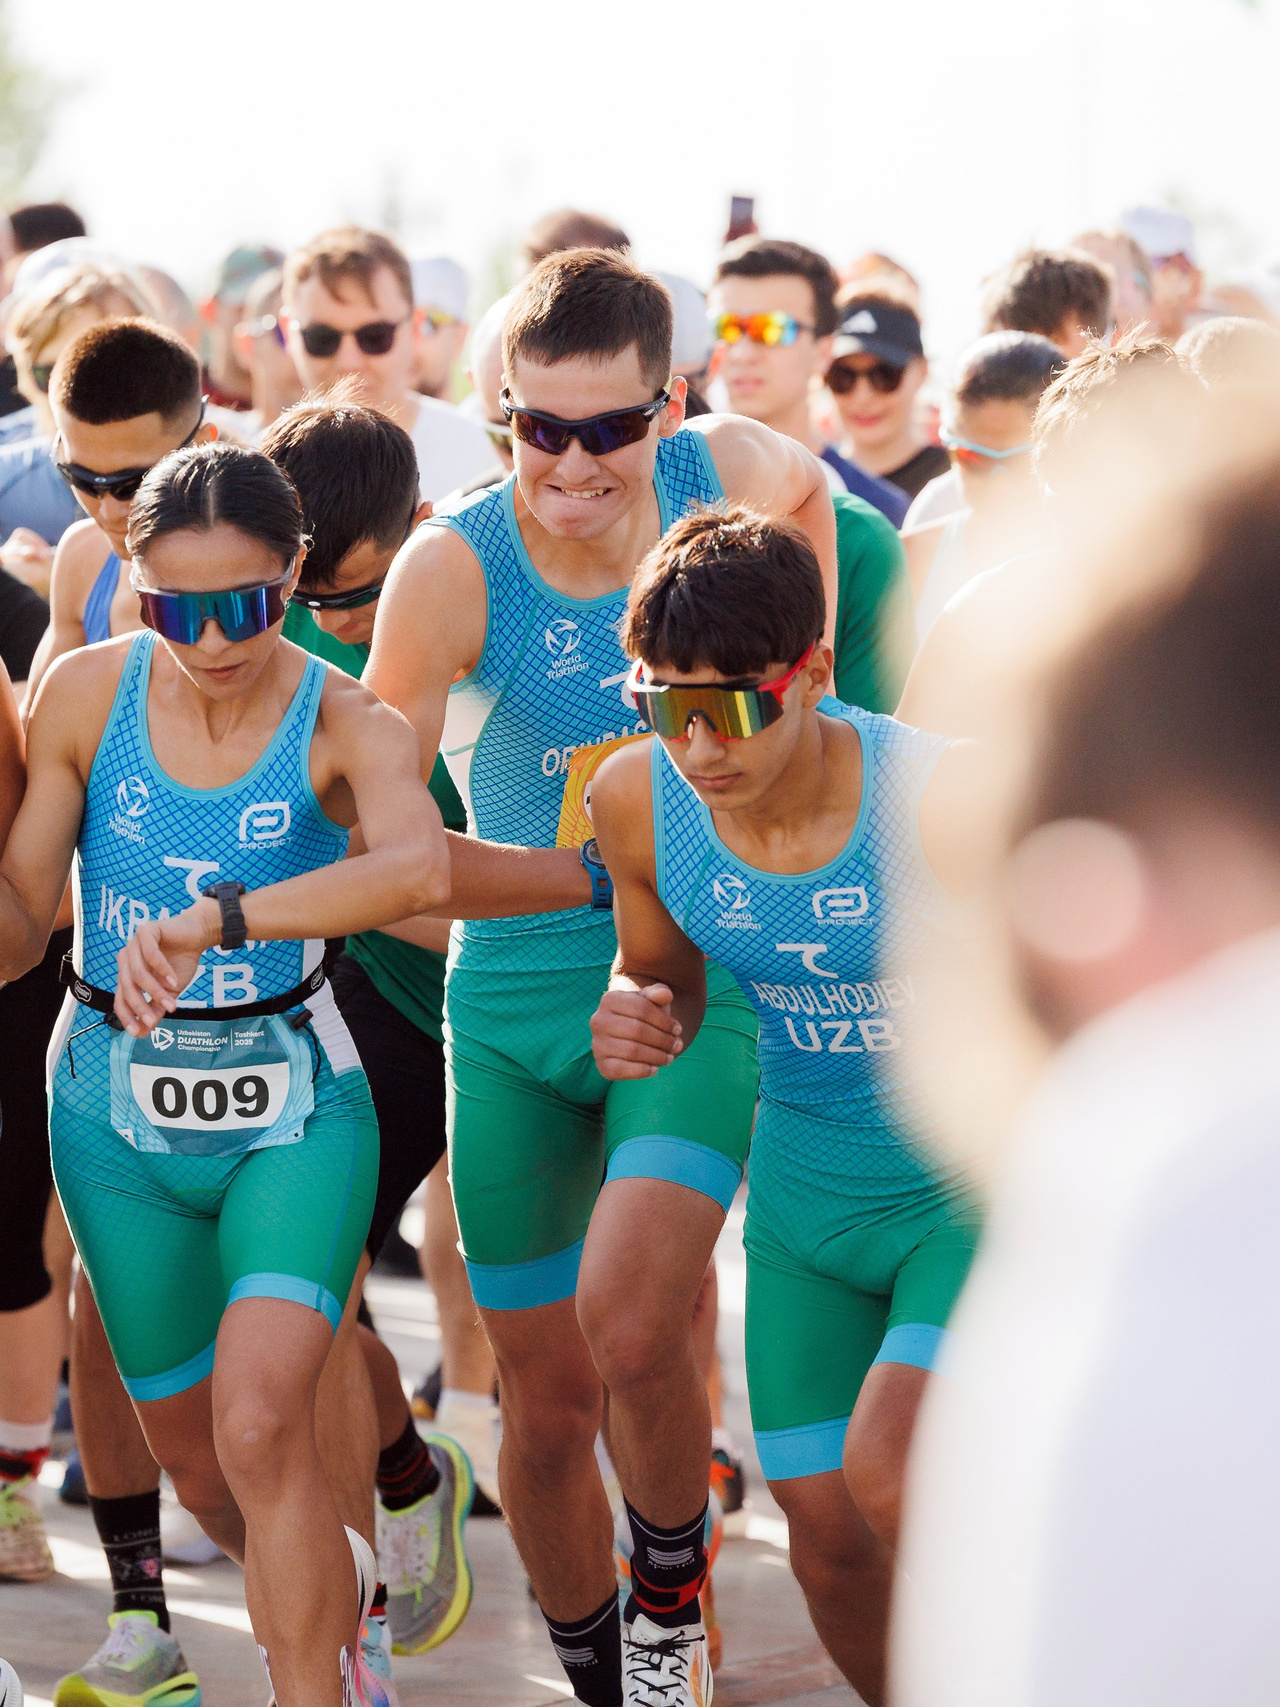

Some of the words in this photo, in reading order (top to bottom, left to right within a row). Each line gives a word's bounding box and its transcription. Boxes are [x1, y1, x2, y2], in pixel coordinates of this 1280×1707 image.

[551, 653, 581, 669] World
[546, 662, 589, 680] Triathlon
[114, 812, 142, 833] World
[108, 818, 145, 845] Triathlon
[238, 836, 293, 850] PROJECT
[720, 911, 752, 922] World
[817, 918, 875, 926] PROJECT
[715, 919, 762, 930] Triathlon
[750, 975, 917, 1016] ABDULHODIEV
[177, 1029, 211, 1037] Uzbekistan
[234, 1030, 265, 1038] Tashkent
[784, 1016, 902, 1053] UZB
[177, 1036, 228, 1046] DUATHLON
[234, 1038, 253, 1046] 2025
[177, 1044, 221, 1052] Championship
[151, 1075, 270, 1121] 009
